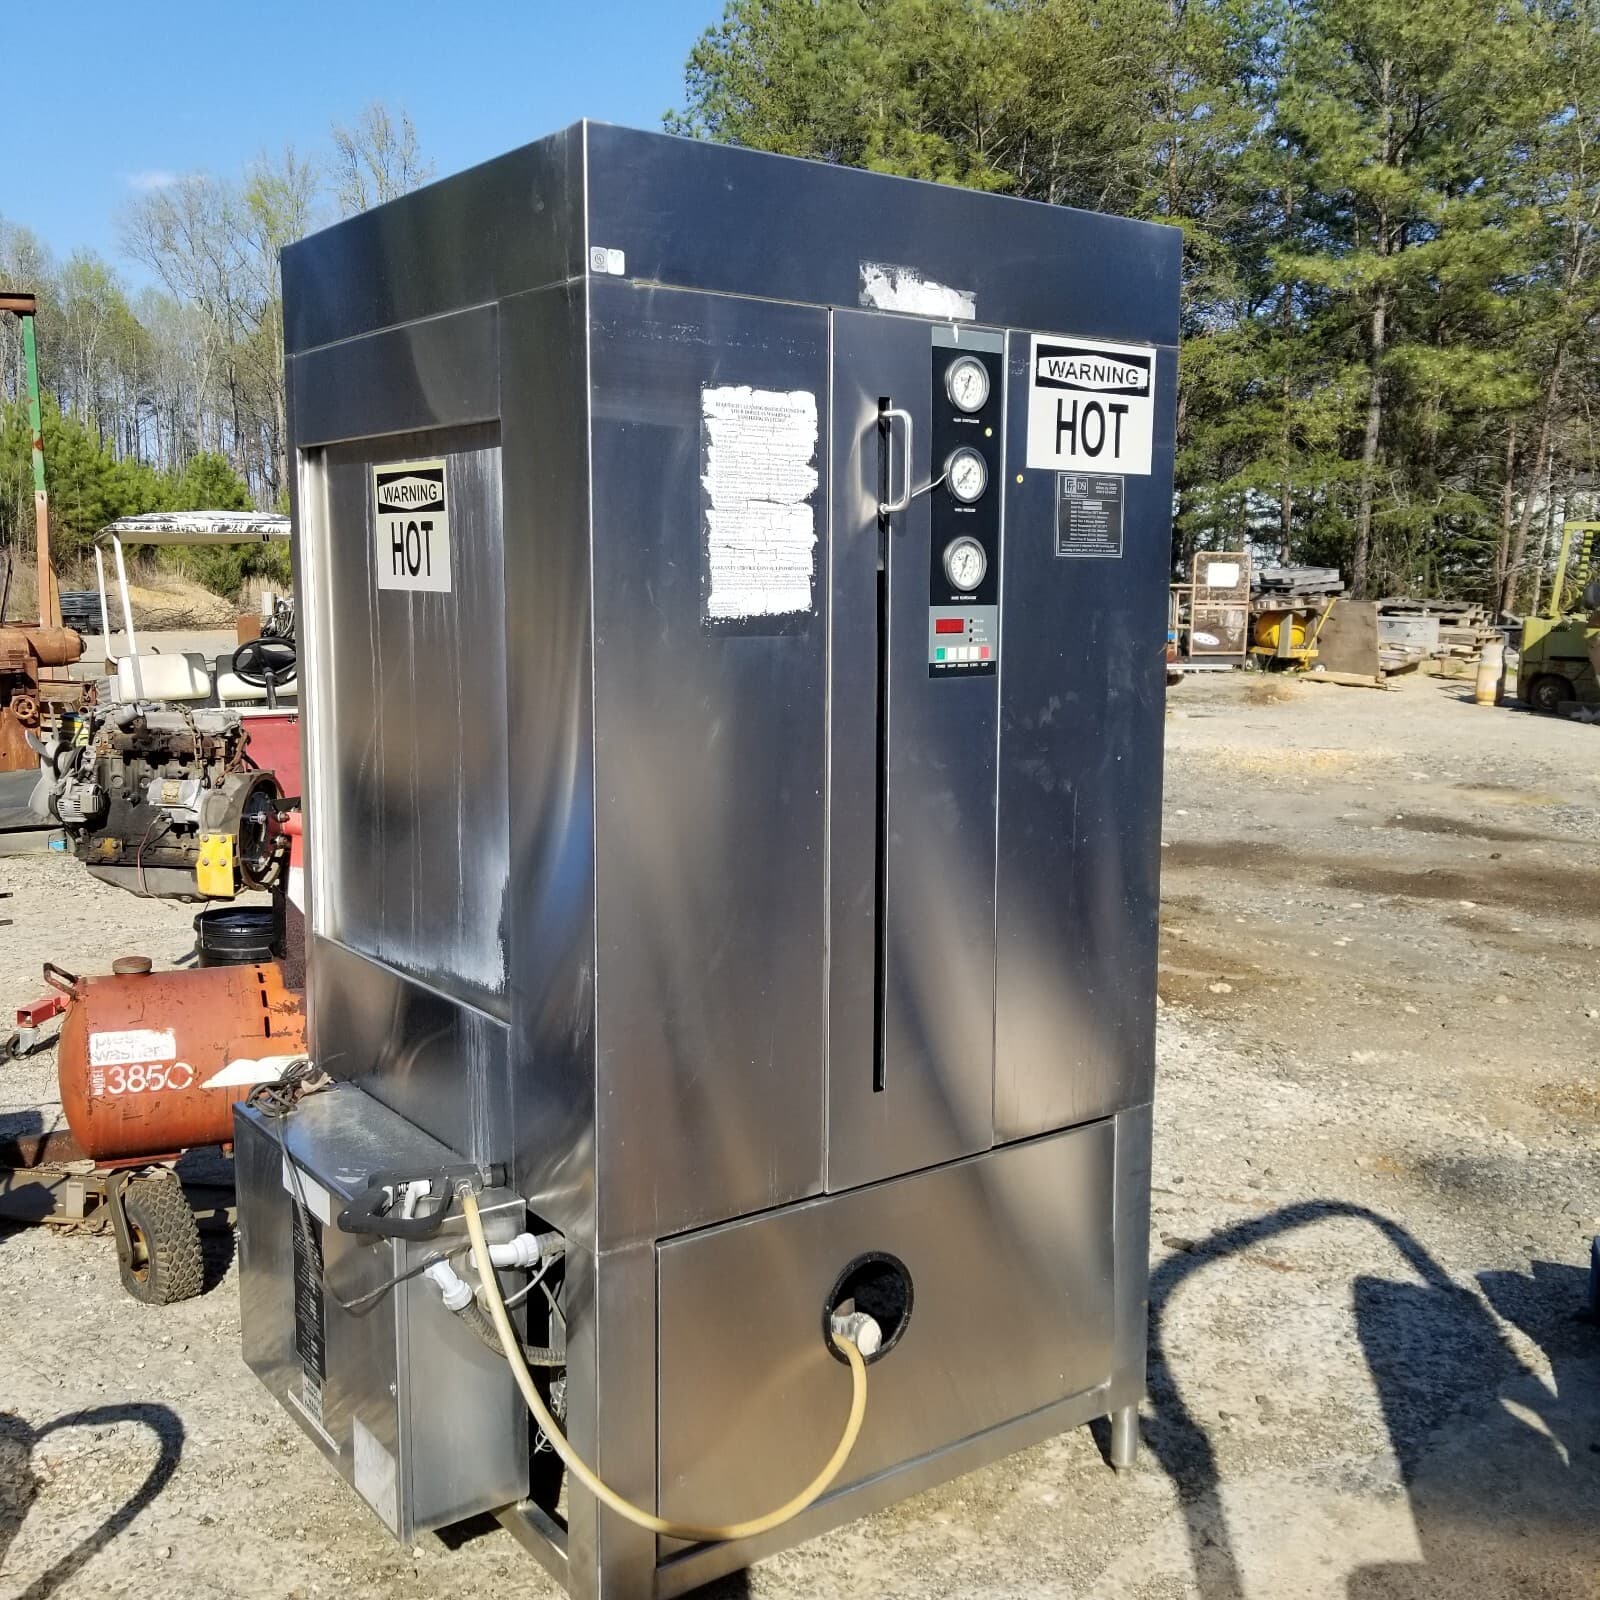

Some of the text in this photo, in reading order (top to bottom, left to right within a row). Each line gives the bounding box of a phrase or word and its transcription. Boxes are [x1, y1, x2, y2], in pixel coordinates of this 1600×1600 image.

[1048, 359, 1139, 385] WARNING
[1055, 398, 1129, 459] HOT
[383, 484, 437, 503] WARNING
[391, 520, 433, 577] HOT
[107, 1061, 194, 1095] 3850
